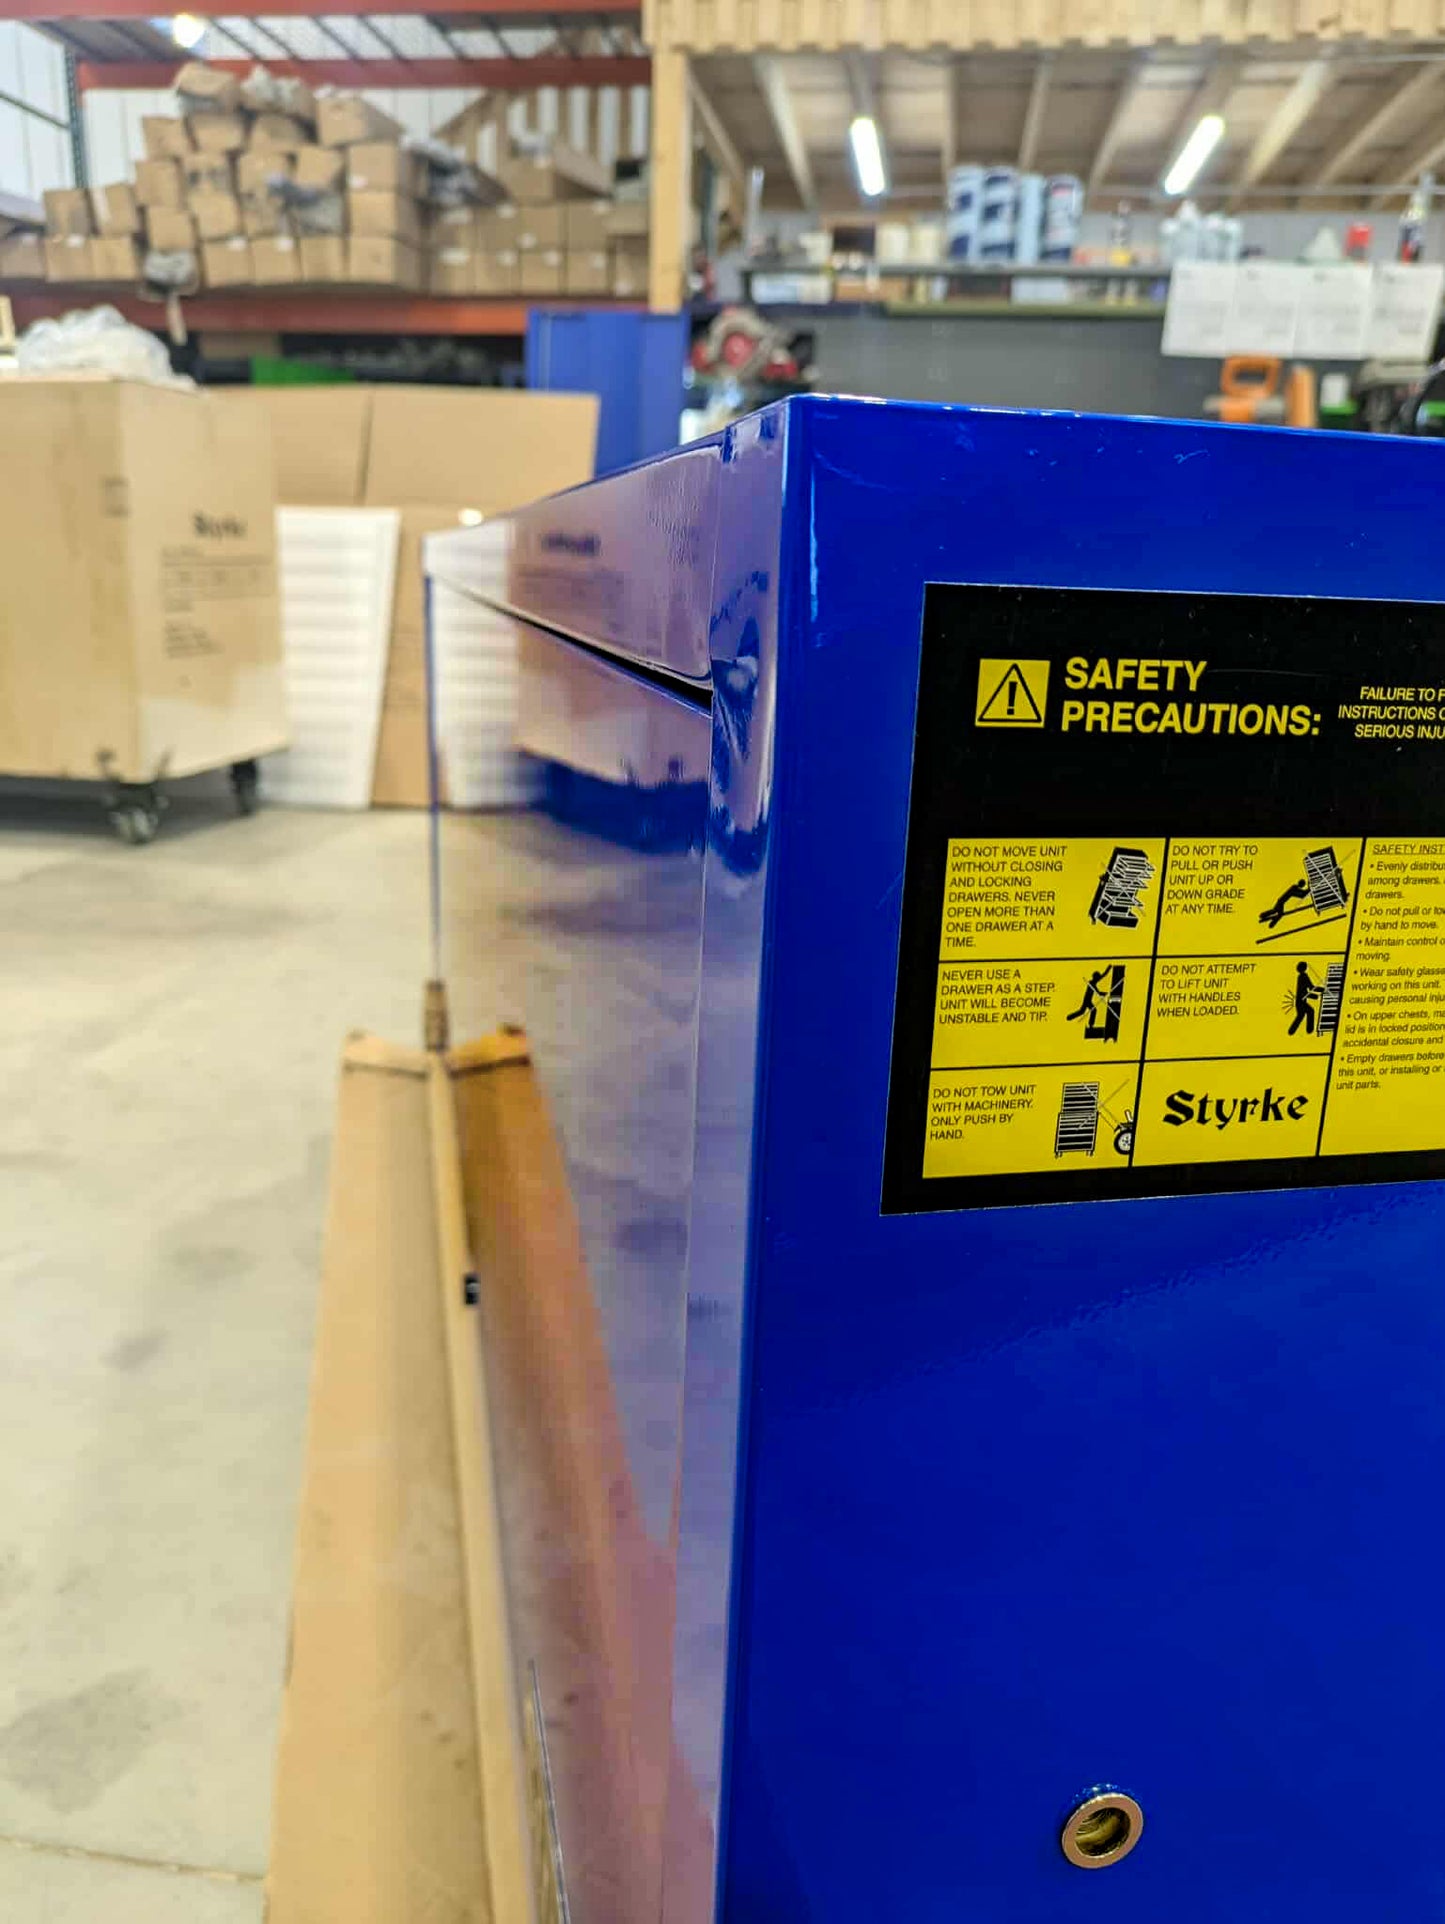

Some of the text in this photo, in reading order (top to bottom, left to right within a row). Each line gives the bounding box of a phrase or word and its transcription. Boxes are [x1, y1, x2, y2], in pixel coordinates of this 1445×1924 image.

[1064, 657, 1207, 692] SAFETY
[1360, 686, 1416, 701] FAILURE
[1417, 687, 1436, 701] TO
[1338, 704, 1437, 720] INSTRUCTIONS
[1061, 701, 1321, 736] PRECAUTIONS:
[1354, 724, 1415, 738] SERIOUS
[952, 845, 1068, 858] DO NOT MOVE UNIT
[1172, 845, 1259, 857] DO NOT TRY TO
[1373, 844, 1445, 855] SAFETY INST
[951, 861, 1064, 873] WITHOUT CLOSING
[1171, 860, 1254, 872] PULL OR PUSH
[1376, 861, 1407, 873] Evenly
[949, 876, 1033, 888] AND LOCKING
[1169, 875, 1234, 886] UNIT UP OR
[1368, 877, 1400, 887] among
[949, 891, 1056, 903] DRAWERS. NEVER
[1167, 889, 1246, 901] DOWN GRADE
[947, 906, 1056, 918] OPEN MORE THAN
[1165, 904, 1236, 915] AT ANY TIME.
[1369, 906, 1383, 916] Do
[1385, 907, 1401, 915] not
[1402, 906, 1420, 917] pull
[1422, 907, 1432, 915] or
[946, 921, 1055, 933] ONE DRAWER AT A
[1361, 921, 1370, 932] by
[1374, 920, 1398, 930] hand
[1401, 921, 1410, 930] to
[945, 937, 977, 948] TIME.
[1364, 938, 1404, 947] Maintain
[1407, 937, 1437, 946] control
[942, 969, 1022, 981] NEVER USE A
[1162, 964, 1257, 976] DO NOT ATTEMPT
[1360, 967, 1384, 977] Wear
[1386, 967, 1414, 978] safety
[941, 983, 1056, 996] DRAWER AS A STEP.
[1160, 979, 1230, 990] TO LIFT UNIT
[1352, 983, 1387, 991] working
[1404, 981, 1420, 989] this
[1158, 992, 1241, 1004] WITH HANDLES
[1349, 996, 1385, 1005] causing
[1388, 994, 1427, 1005] personal
[940, 998, 1052, 1011] UNIT WILL BECOME
[1157, 1006, 1240, 1018] WHEN LOADED.
[1354, 1011, 1367, 1020] On
[1370, 1012, 1395, 1021] upper
[939, 1012, 1049, 1025] UNSTABLE AND TIP.
[1345, 1025, 1355, 1034] lid
[1358, 1025, 1365, 1033] is
[1368, 1024, 1376, 1032] in
[1380, 1024, 1408, 1032] locked
[1343, 1035, 1443, 1047] accidental closure and
[1347, 1052, 1444, 1064] Empty drawers before
[1338, 1067, 1354, 1076] this
[1390, 1065, 1429, 1075] installing
[1336, 1080, 1353, 1090] unit
[933, 1085, 1036, 1099] DO NOT TOW UNIT
[932, 1100, 1034, 1113] WITH MACHINERY.
[1163, 1087, 1309, 1131] Styrke
[931, 1113, 1014, 1127] ONLY PUSH BY
[930, 1131, 965, 1141] HAND.
